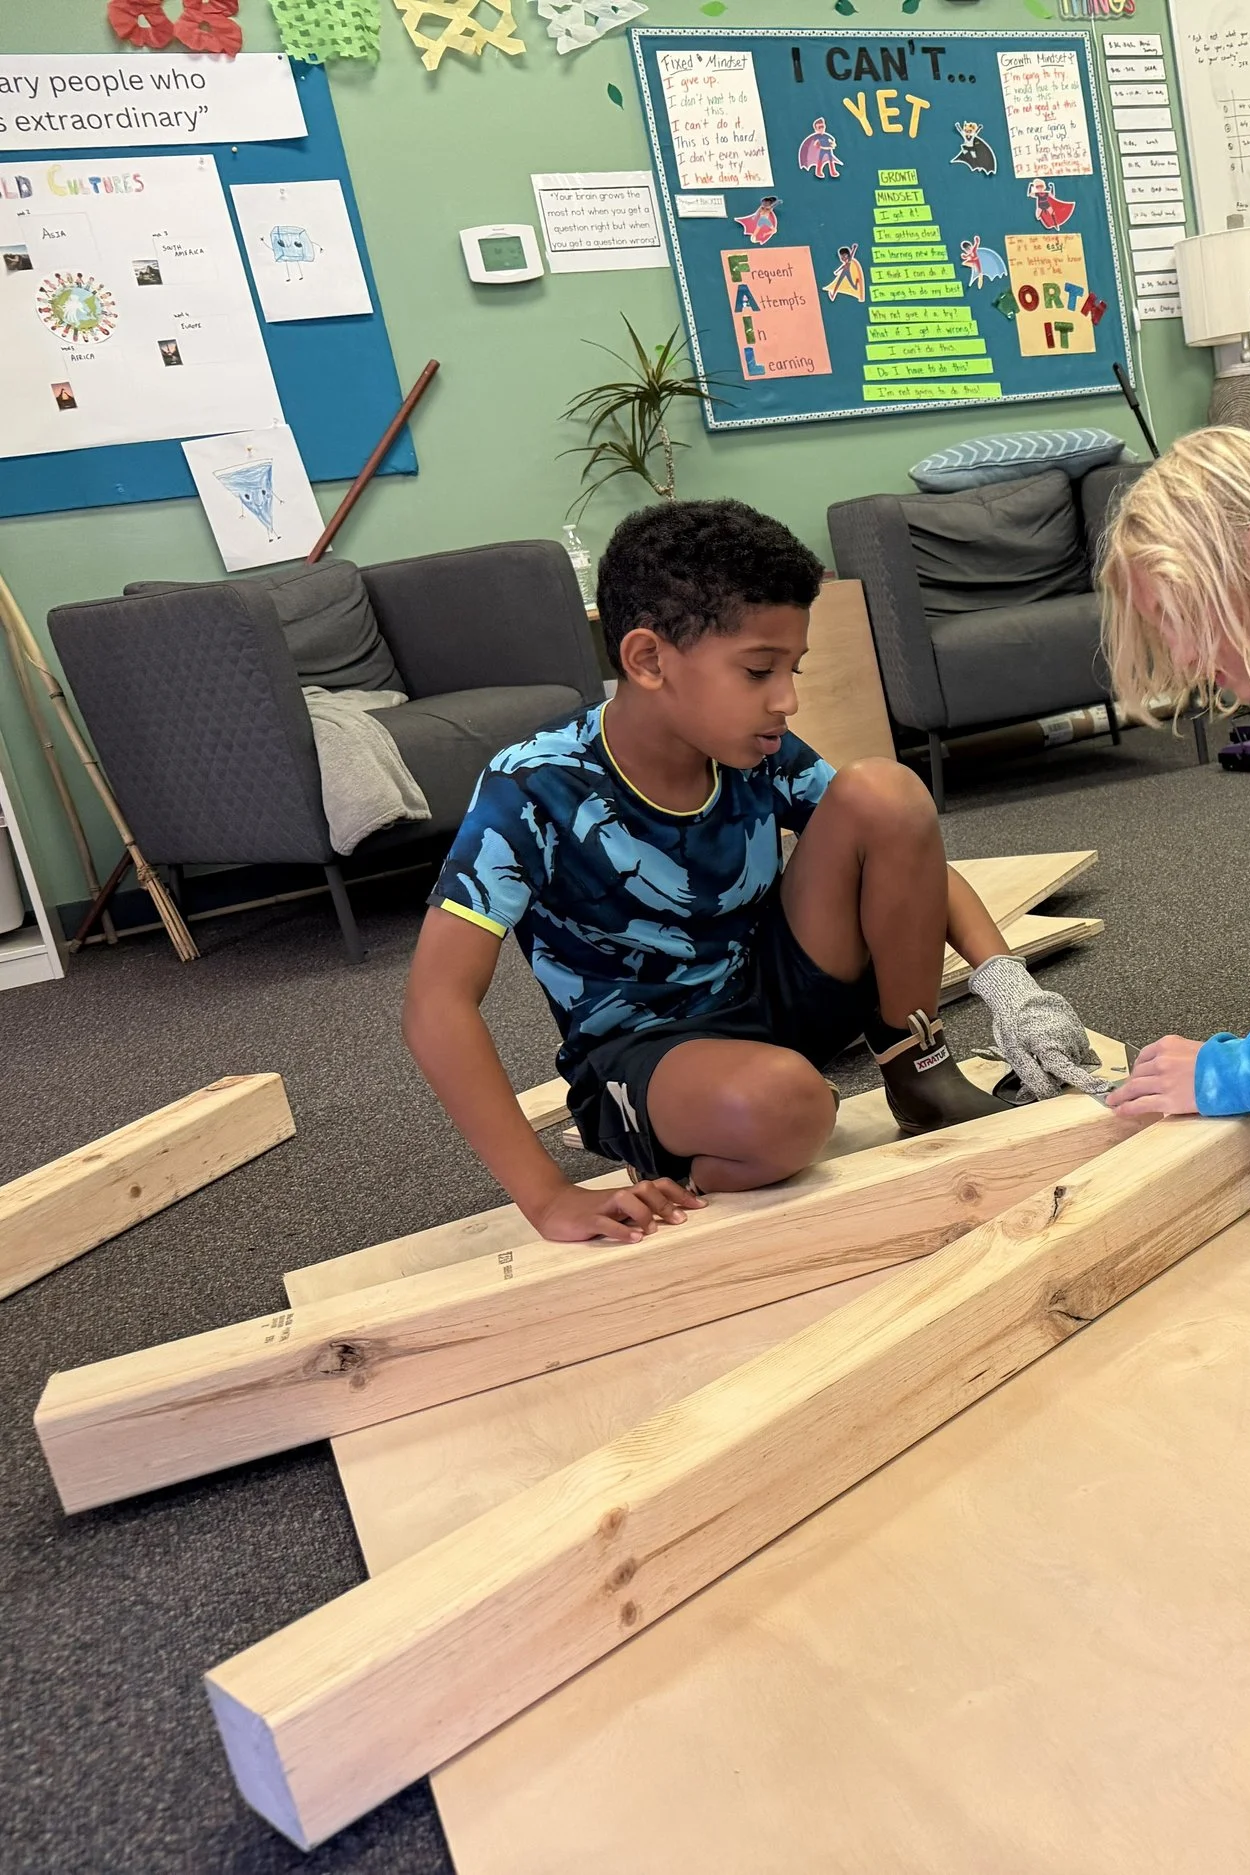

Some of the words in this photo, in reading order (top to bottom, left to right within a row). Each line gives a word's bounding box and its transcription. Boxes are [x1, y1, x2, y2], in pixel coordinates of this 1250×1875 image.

[661, 54, 693, 72] Fixed
[705, 56, 748, 69] Mindset
[792, 47, 804, 83] I
[826, 39, 976, 84] CAN'T...
[1001, 53, 1032, 67] Growth
[1037, 53, 1067, 64] Mindset
[50, 69, 144, 98] people
[150, 68, 206, 90] who
[664, 77, 674, 89] I
[681, 76, 699, 92] give
[668, 95, 677, 108] I
[681, 93, 703, 107] don't
[728, 92, 736, 103] to
[738, 91, 748, 103] do
[843, 89, 931, 139] YET
[672, 120, 680, 132] I
[685, 119, 708, 131] can't
[717, 118, 728, 129] do
[674, 135, 696, 150] This
[702, 136, 710, 146] is
[716, 134, 729, 144] too
[677, 153, 686, 165] I
[690, 151, 715, 163] don't
[718, 150, 739, 161] even
[744, 146, 765, 157] want
[715, 160, 724, 170] to
[0, 175, 33, 199] LD
[47, 164, 146, 197] CULTURES
[682, 174, 690, 186] I
[695, 172, 714, 184] hate
[718, 171, 739, 186] doing
[880, 171, 916, 183] GROWTH
[576, 191, 597, 201] brain
[600, 192, 623, 203] grows
[627, 190, 640, 199] the
[877, 191, 919, 203] MINDSET
[547, 208, 568, 217] most
[571, 207, 585, 217] not
[587, 206, 609, 216] when
[611, 208, 626, 217] you
[628, 206, 641, 217] get
[880, 211, 889, 220] I
[554, 223, 589, 234] question
[591, 221, 610, 233] right
[612, 221, 625, 230] but
[629, 220, 650, 230] when
[895, 230, 920, 241] getting
[162, 244, 182, 252] SOUTH
[552, 241, 567, 251] you
[569, 240, 583, 250] get
[594, 237, 627, 248] question
[174, 248, 205, 257] AMERICA
[876, 270, 883, 279] I
[929, 268, 937, 276] do
[909, 288, 917, 296] to
[920, 287, 928, 295] do
[945, 284, 960, 293] best
[890, 309, 900, 317] not
[870, 328, 888, 338] What
[906, 326, 911, 336] I
[1044, 321, 1074, 349] IT
[888, 346, 896, 355] I
[926, 344, 934, 352] do
[877, 367, 888, 377] Do
[893, 367, 899, 375] I
[906, 366, 924, 375] have
[928, 364, 936, 373] to
[939, 363, 947, 373] do
[898, 387, 910, 396] not
[938, 386, 946, 394] to
[950, 386, 958, 395] do
